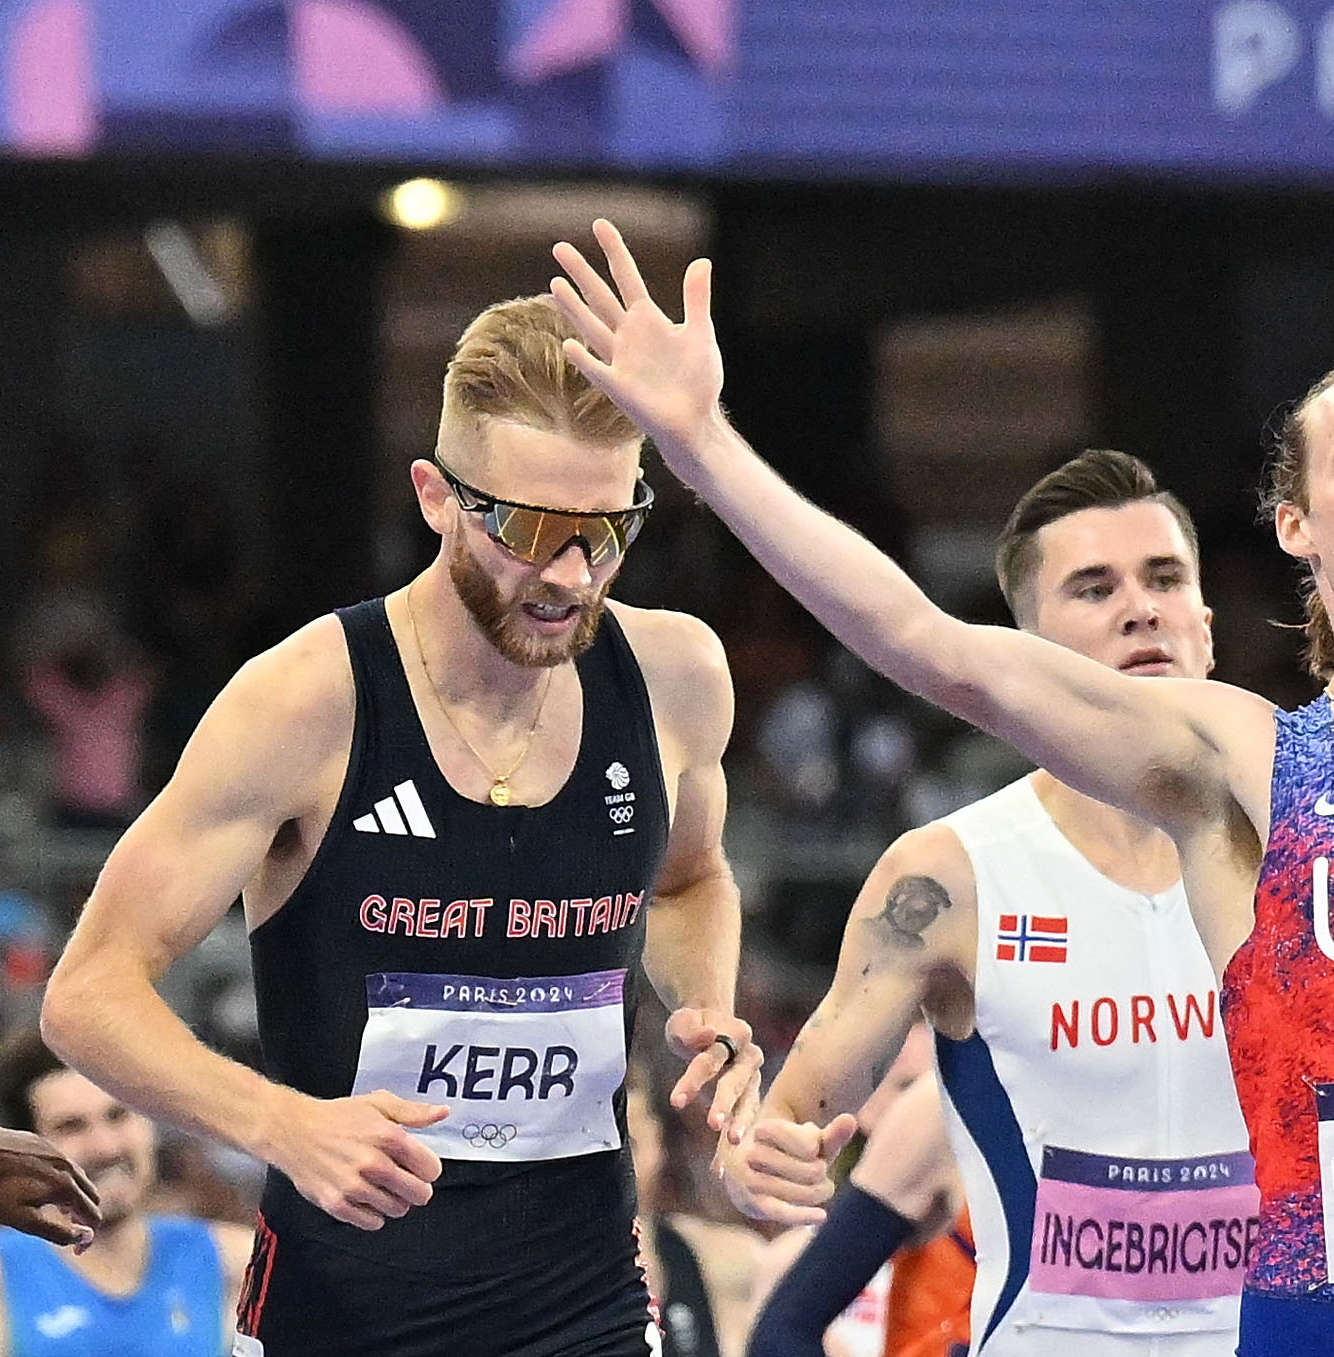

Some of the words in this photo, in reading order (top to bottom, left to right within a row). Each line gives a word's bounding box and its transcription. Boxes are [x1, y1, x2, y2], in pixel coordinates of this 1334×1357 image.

[359, 894, 493, 938] GREAT
[507, 888, 646, 938] BRITAIN
[443, 985, 509, 1003] PARIS
[515, 986, 573, 1003] 2024
[417, 1044, 579, 1100] KERR
[1107, 1164, 1171, 1183] PARIS
[1180, 1163, 1231, 1183] 2024
